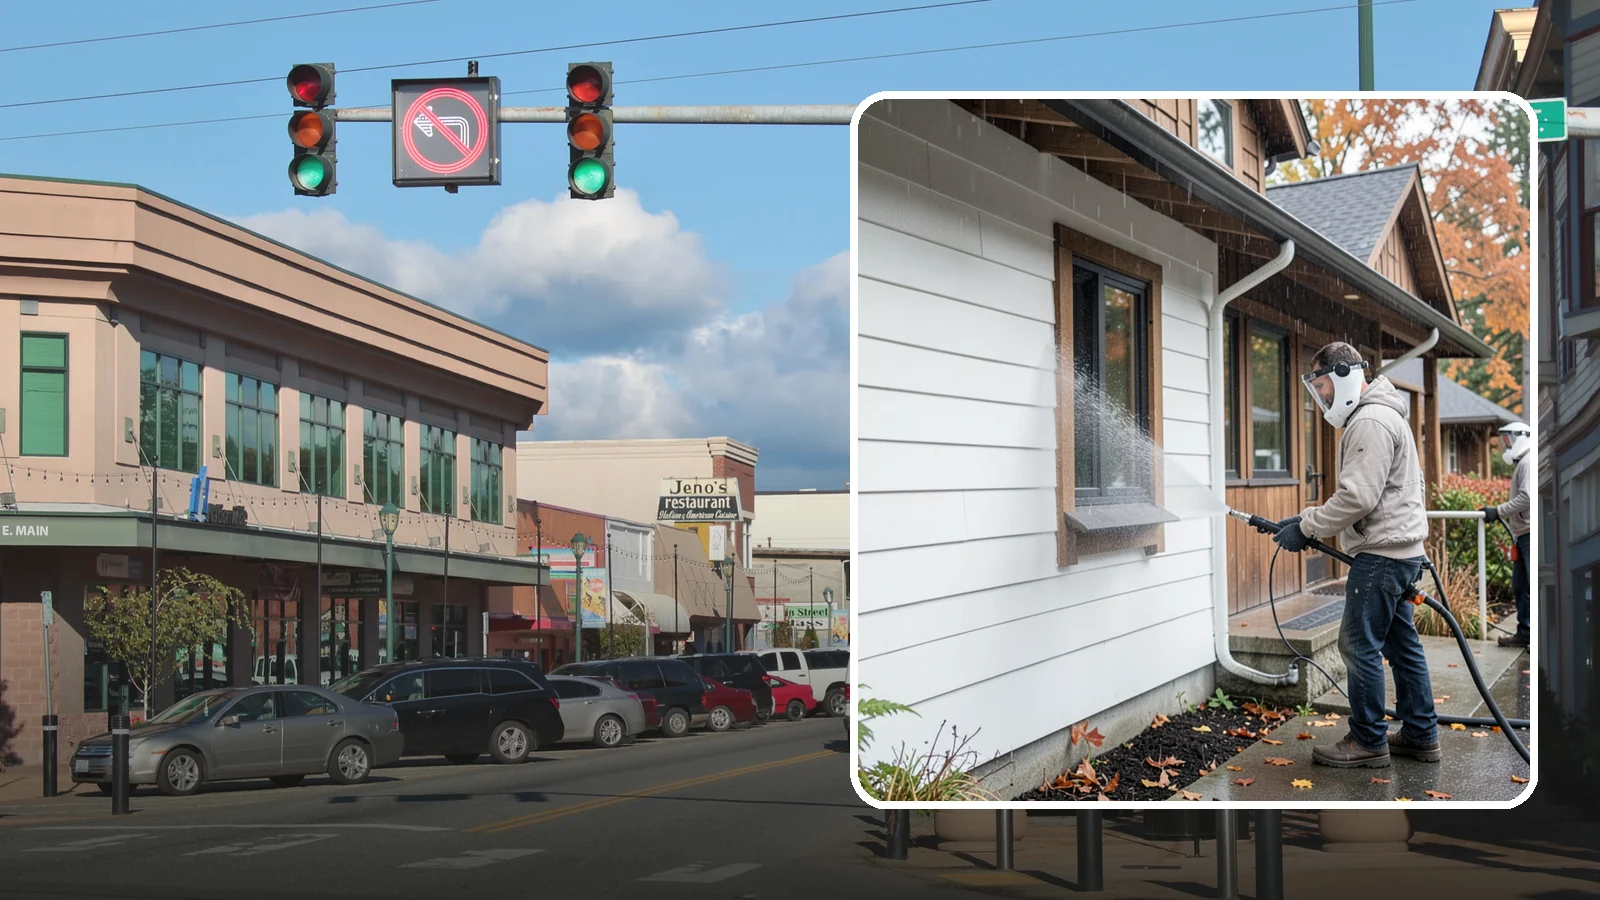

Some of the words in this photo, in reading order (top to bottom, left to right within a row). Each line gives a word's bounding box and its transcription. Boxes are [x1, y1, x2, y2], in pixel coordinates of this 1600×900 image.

[670, 480, 728, 494] Jeno's
[665, 496, 731, 509] restaurant
[658, 510, 681, 519] Italian
[686, 510, 715, 519] American
[715, 509, 738, 519] Cuisine
[2, 525, 13, 536] E.
[15, 525, 49, 536] MAIN
[797, 607, 829, 617] Street
